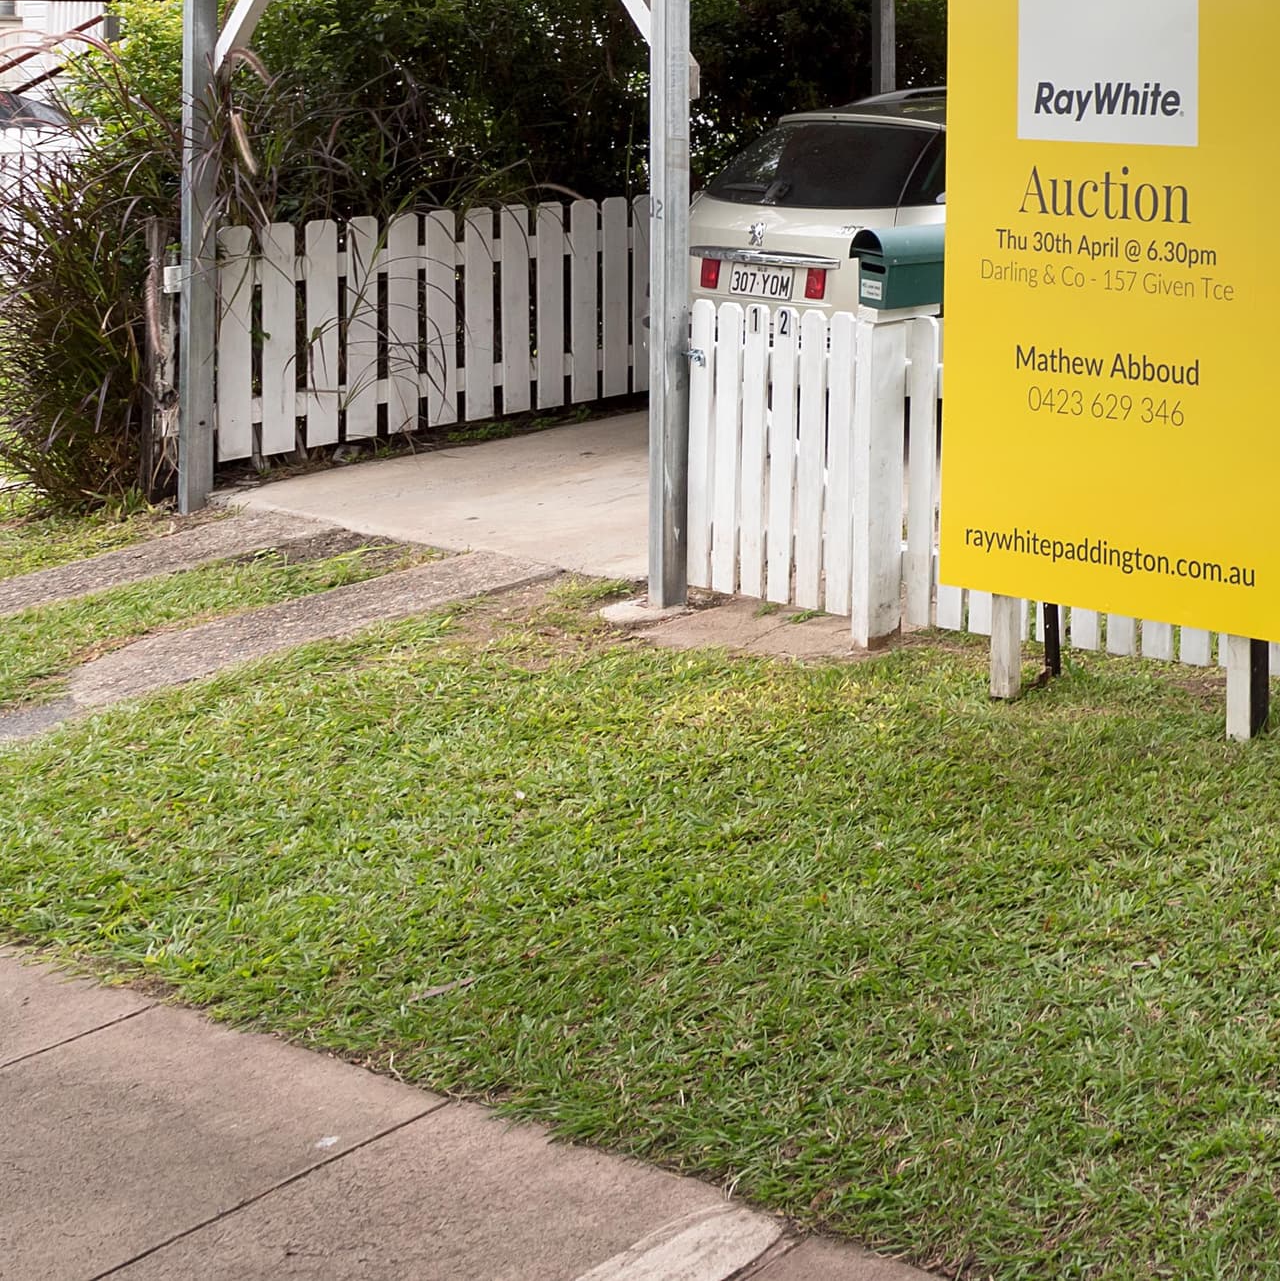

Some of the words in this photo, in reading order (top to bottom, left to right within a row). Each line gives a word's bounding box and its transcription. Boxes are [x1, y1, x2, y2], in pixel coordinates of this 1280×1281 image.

[1018, 165, 1192, 224] Auction
[995, 229, 1028, 251] Thu
[1032, 231, 1072, 254] 30th
[1077, 235, 1119, 260] April
[1124, 239, 1141, 263] @
[1146, 240, 1217, 268] 6.30pm
[980, 258, 1038, 288] Darling
[1043, 264, 1056, 285] &
[1061, 265, 1085, 288] Co
[1103, 269, 1137, 292] 157
[1142, 272, 1194, 298] Given
[1201, 277, 1234, 302] Tce
[1015, 344, 1104, 377] Mathew
[1110, 353, 1200, 386] Abboud
[1028, 385, 1084, 416] 0423
[1091, 392, 1132, 421] 629
[1140, 397, 1185, 427] 346
[965, 527, 1256, 587] raywhitepaddington.com.au
